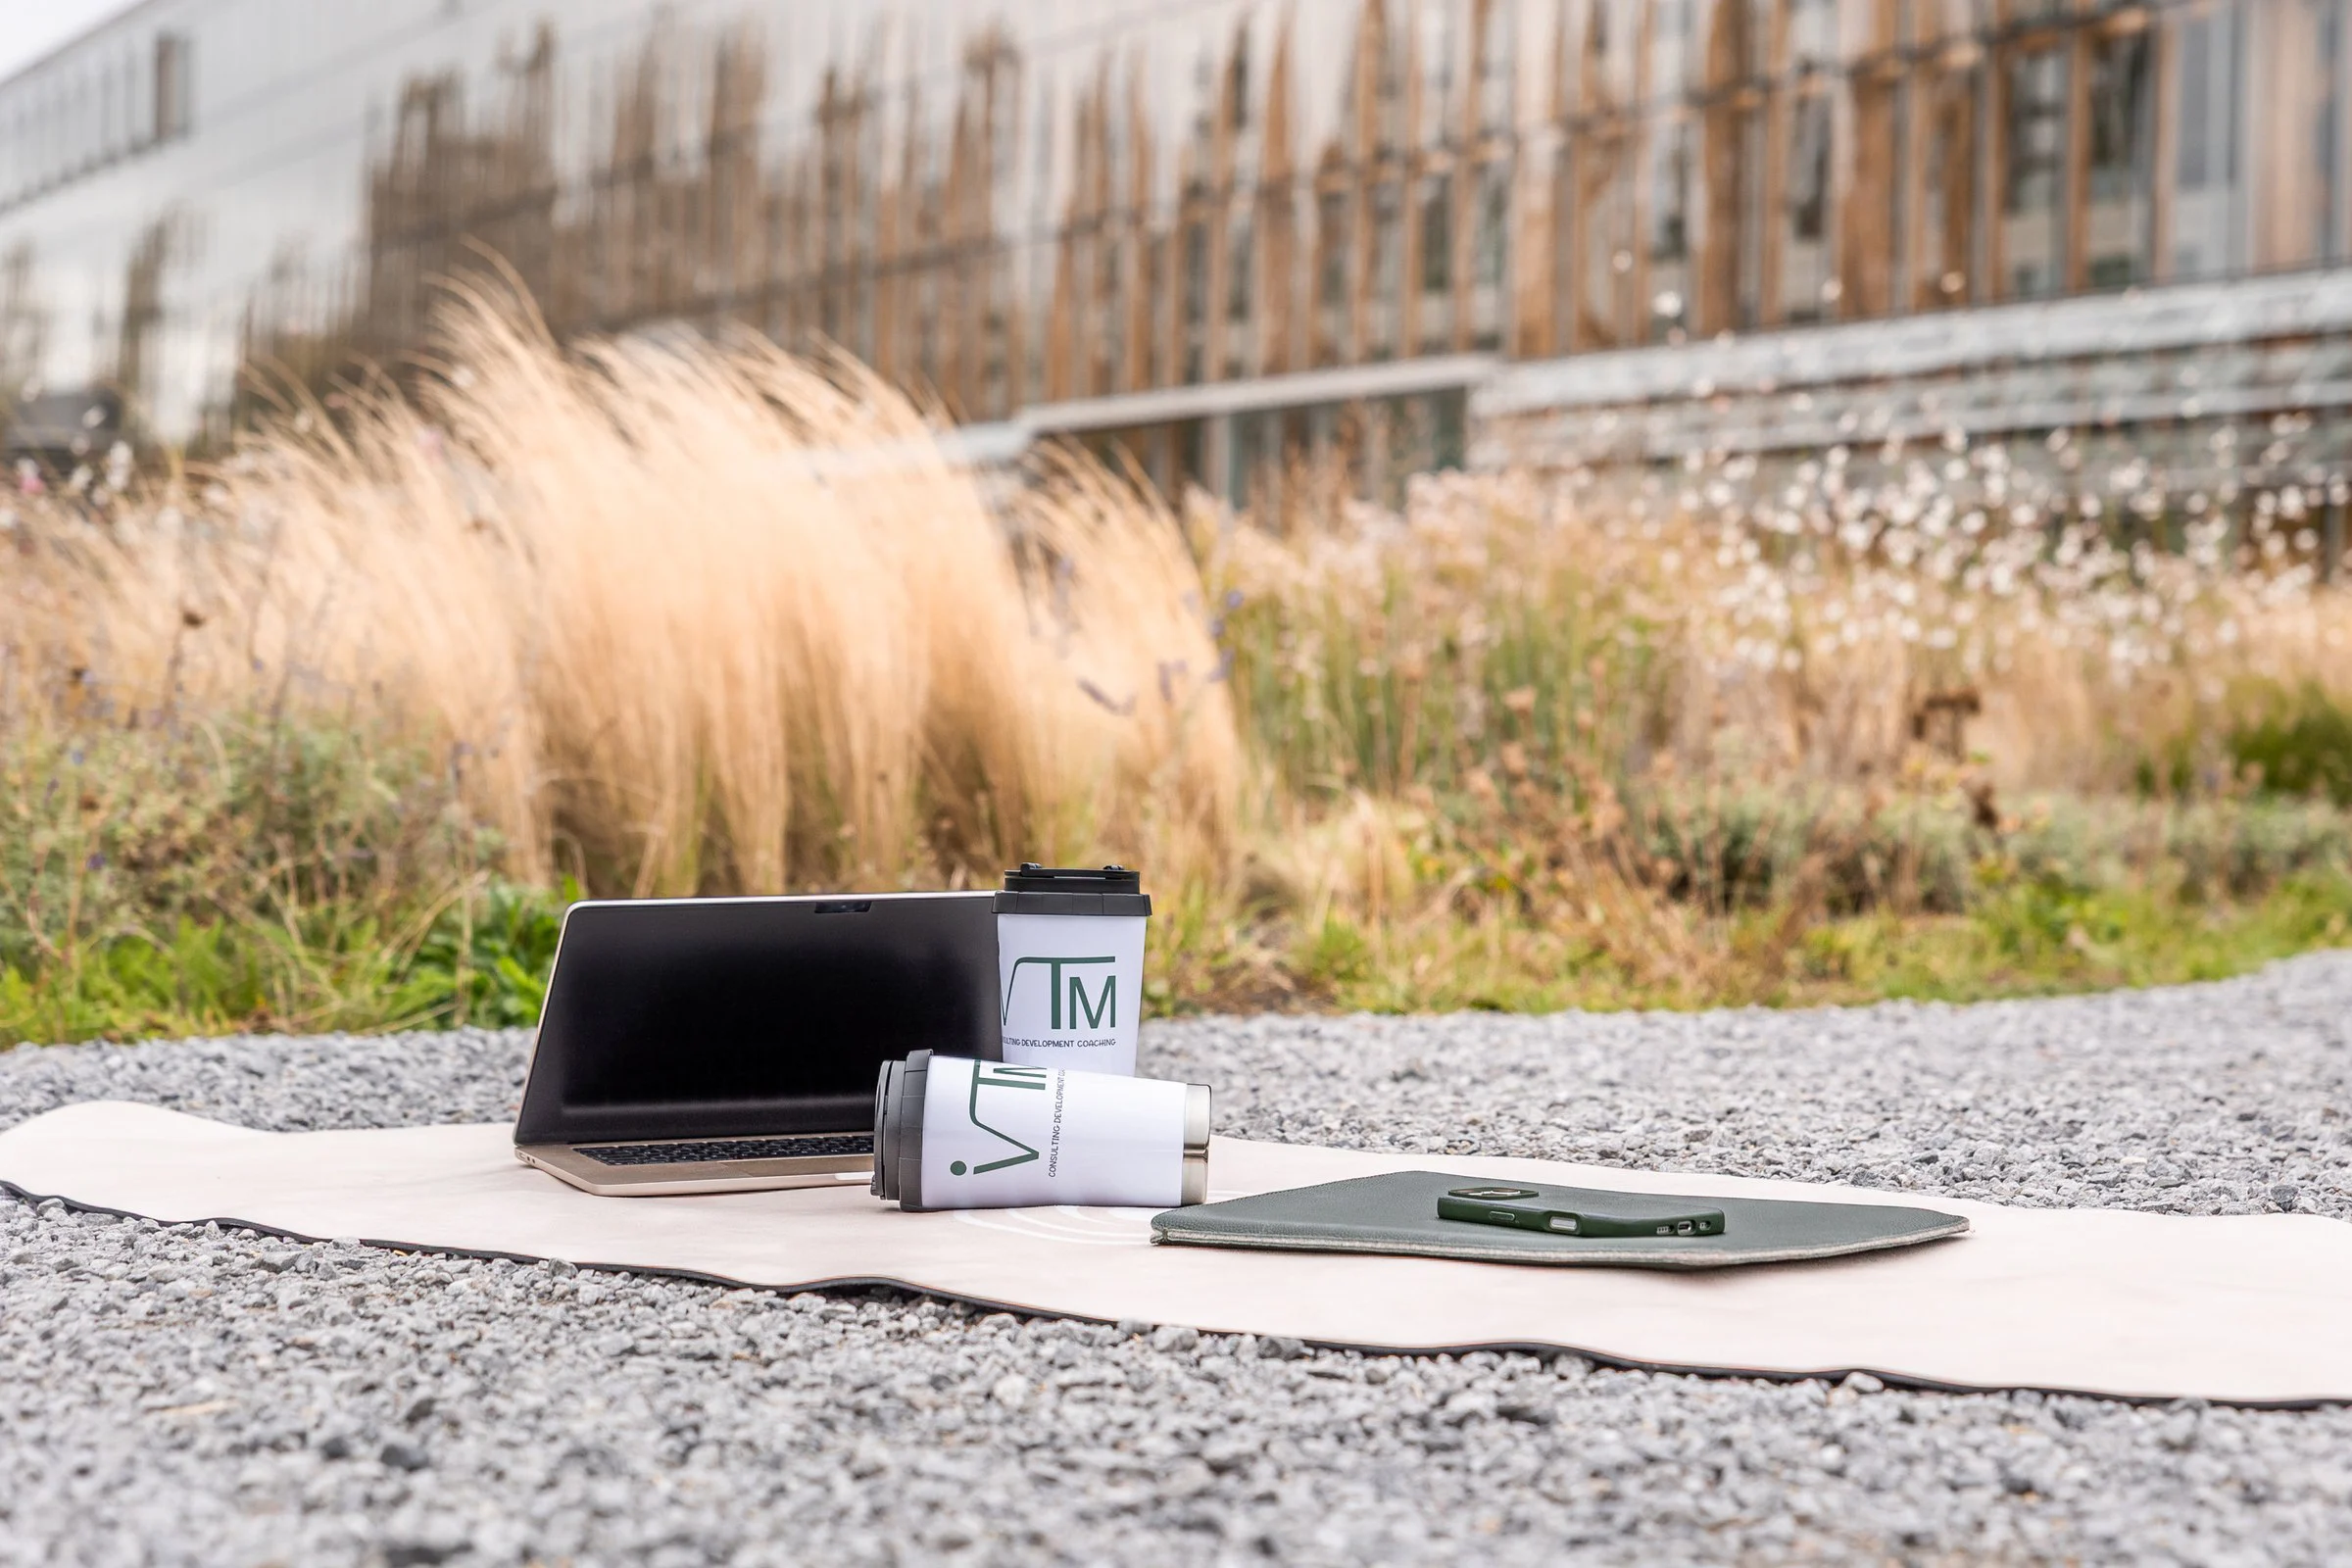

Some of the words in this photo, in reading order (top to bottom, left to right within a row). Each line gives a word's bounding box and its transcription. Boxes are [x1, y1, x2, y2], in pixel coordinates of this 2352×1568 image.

[1021, 1039, 1075, 1048] DEVELOPMENT
[1077, 1038, 1116, 1048] COACHING
[1054, 1077, 1065, 1124] DEVELOPMENT
[1049, 1124, 1060, 1178] CONSULTING
